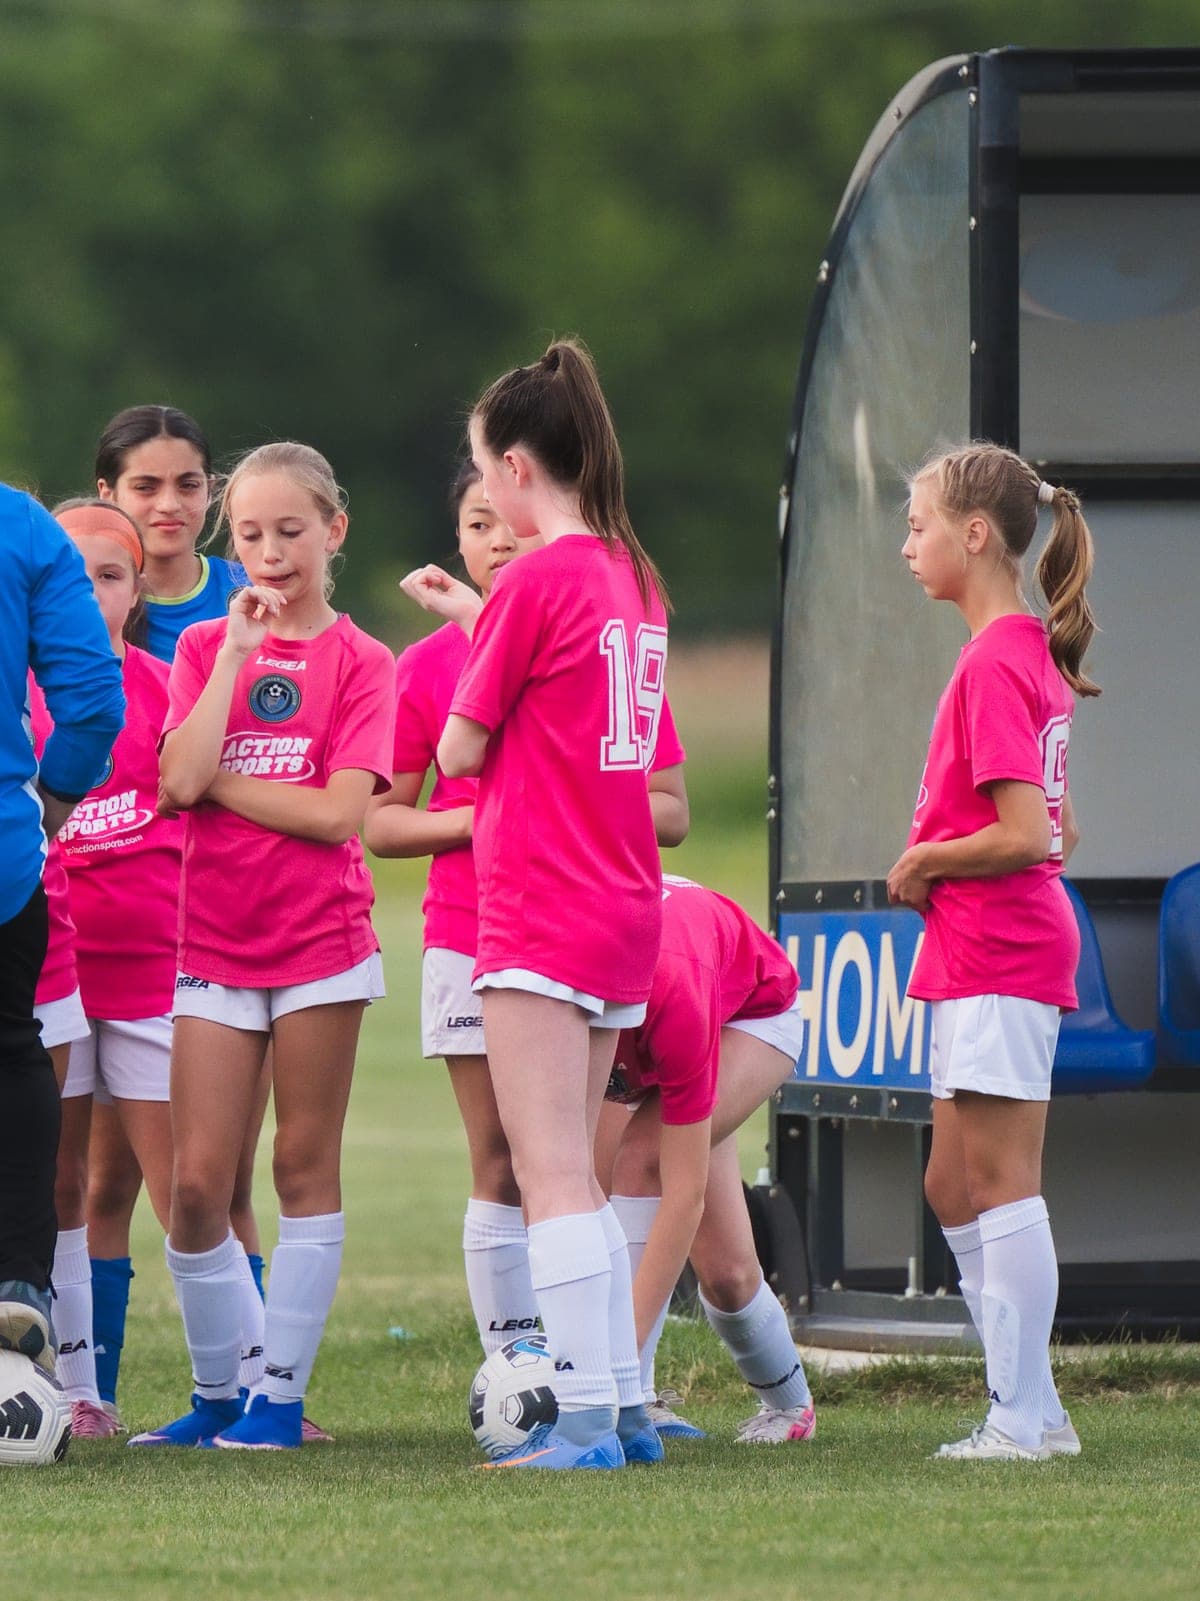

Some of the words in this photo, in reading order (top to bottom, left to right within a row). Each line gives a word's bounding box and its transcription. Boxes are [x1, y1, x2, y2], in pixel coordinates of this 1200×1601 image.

[256, 656, 307, 671] LEGEA
[599, 619, 668, 776] 19
[222, 737, 313, 760] ACTION
[71, 789, 138, 820] CTION
[58, 809, 137, 843] SPORTS
[176, 975, 210, 989] EGEA
[786, 930, 933, 1079] HOM
[447, 1016, 484, 1028] LEGE
